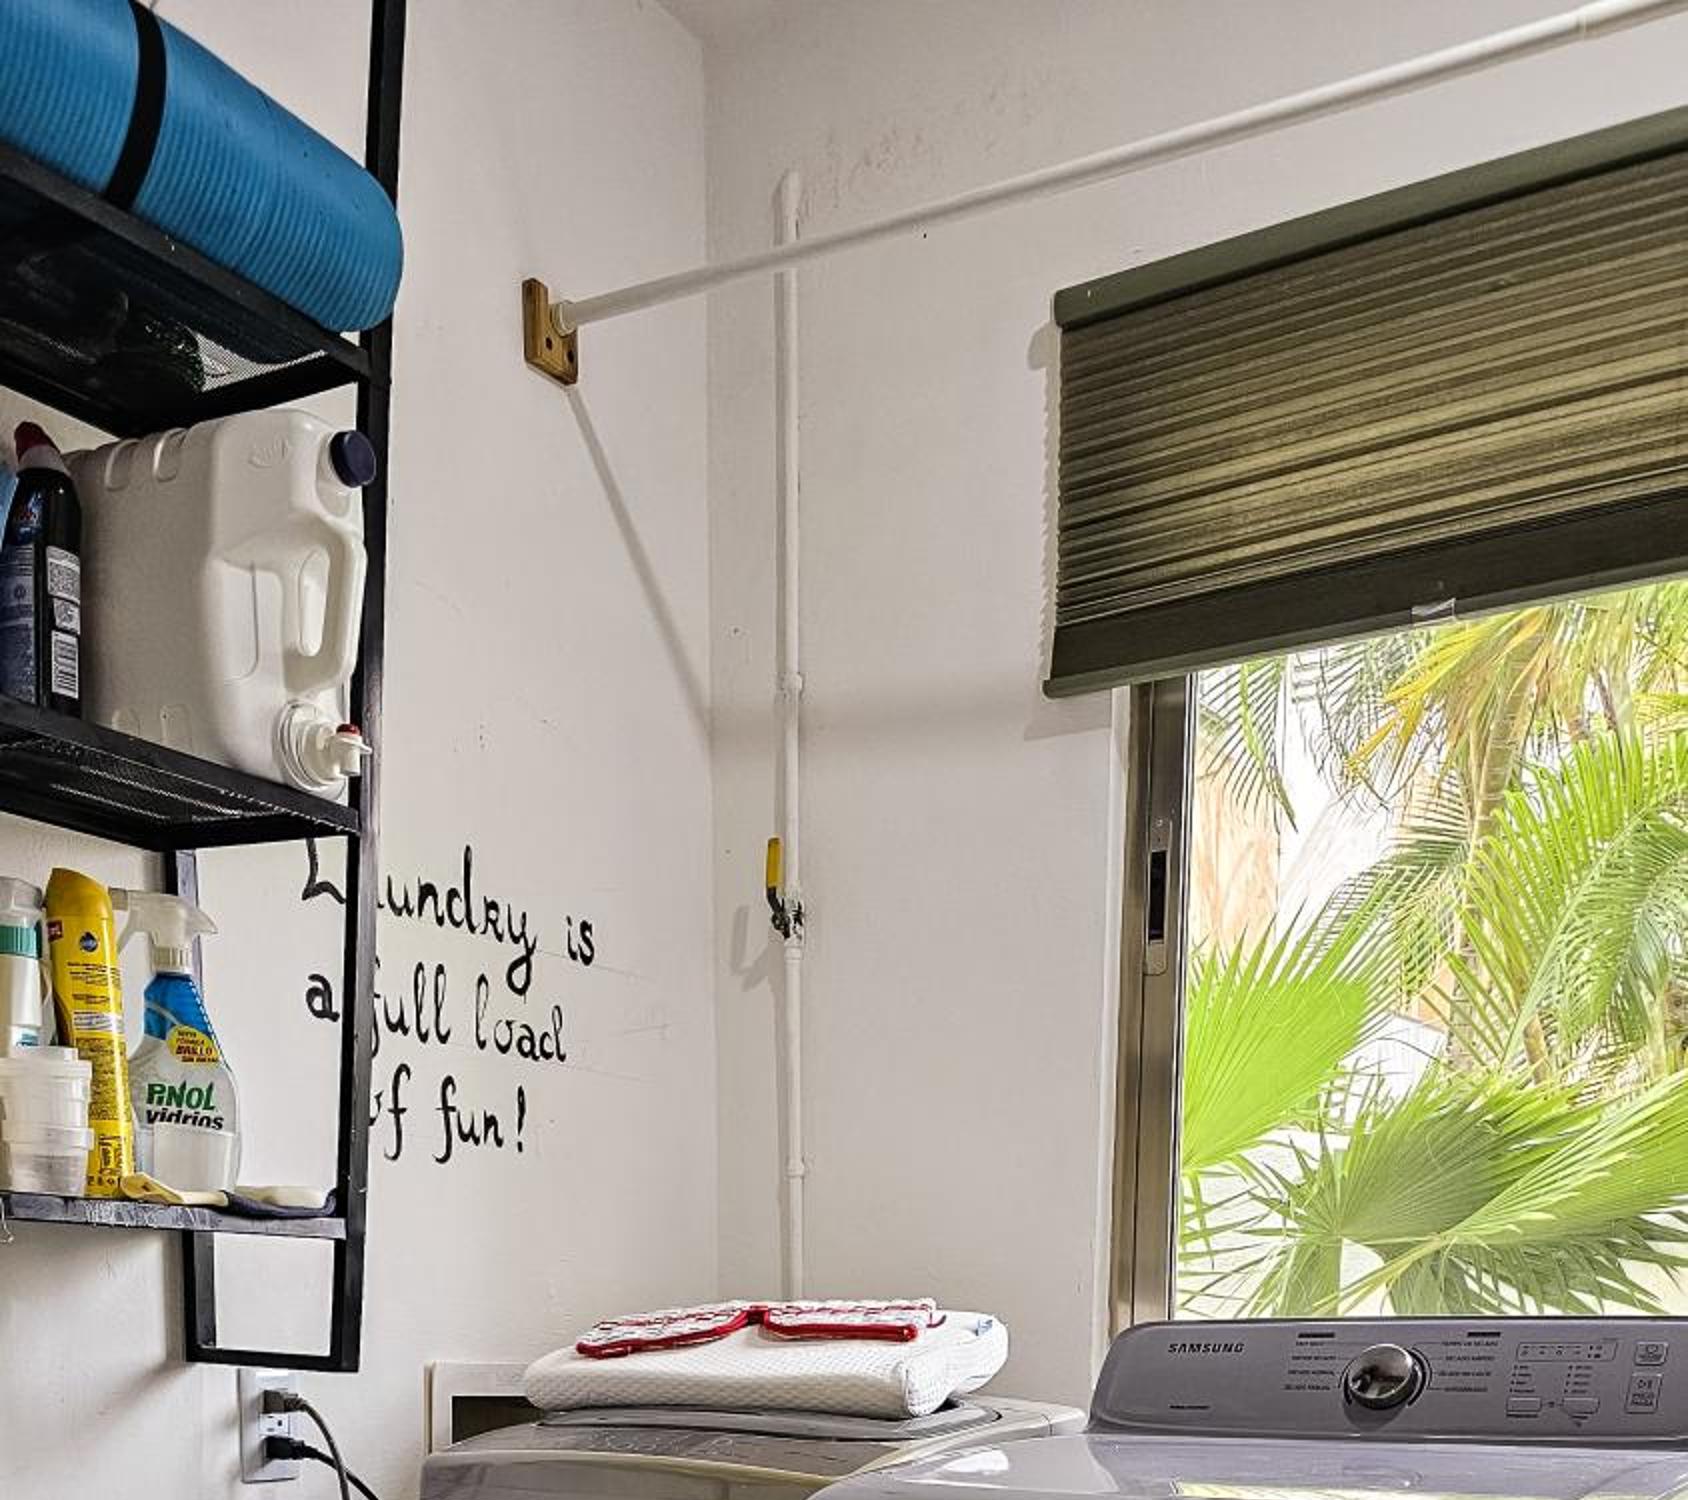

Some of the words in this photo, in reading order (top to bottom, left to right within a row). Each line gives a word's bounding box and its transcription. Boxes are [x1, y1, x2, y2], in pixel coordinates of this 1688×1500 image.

[302, 838, 536, 995] Lundry
[565, 915, 595, 966] is
[305, 973, 341, 1022] a
[475, 973, 567, 1062] load
[433, 1074, 527, 1164] fun!
[1168, 1343, 1245, 1353] SAMSUNG
